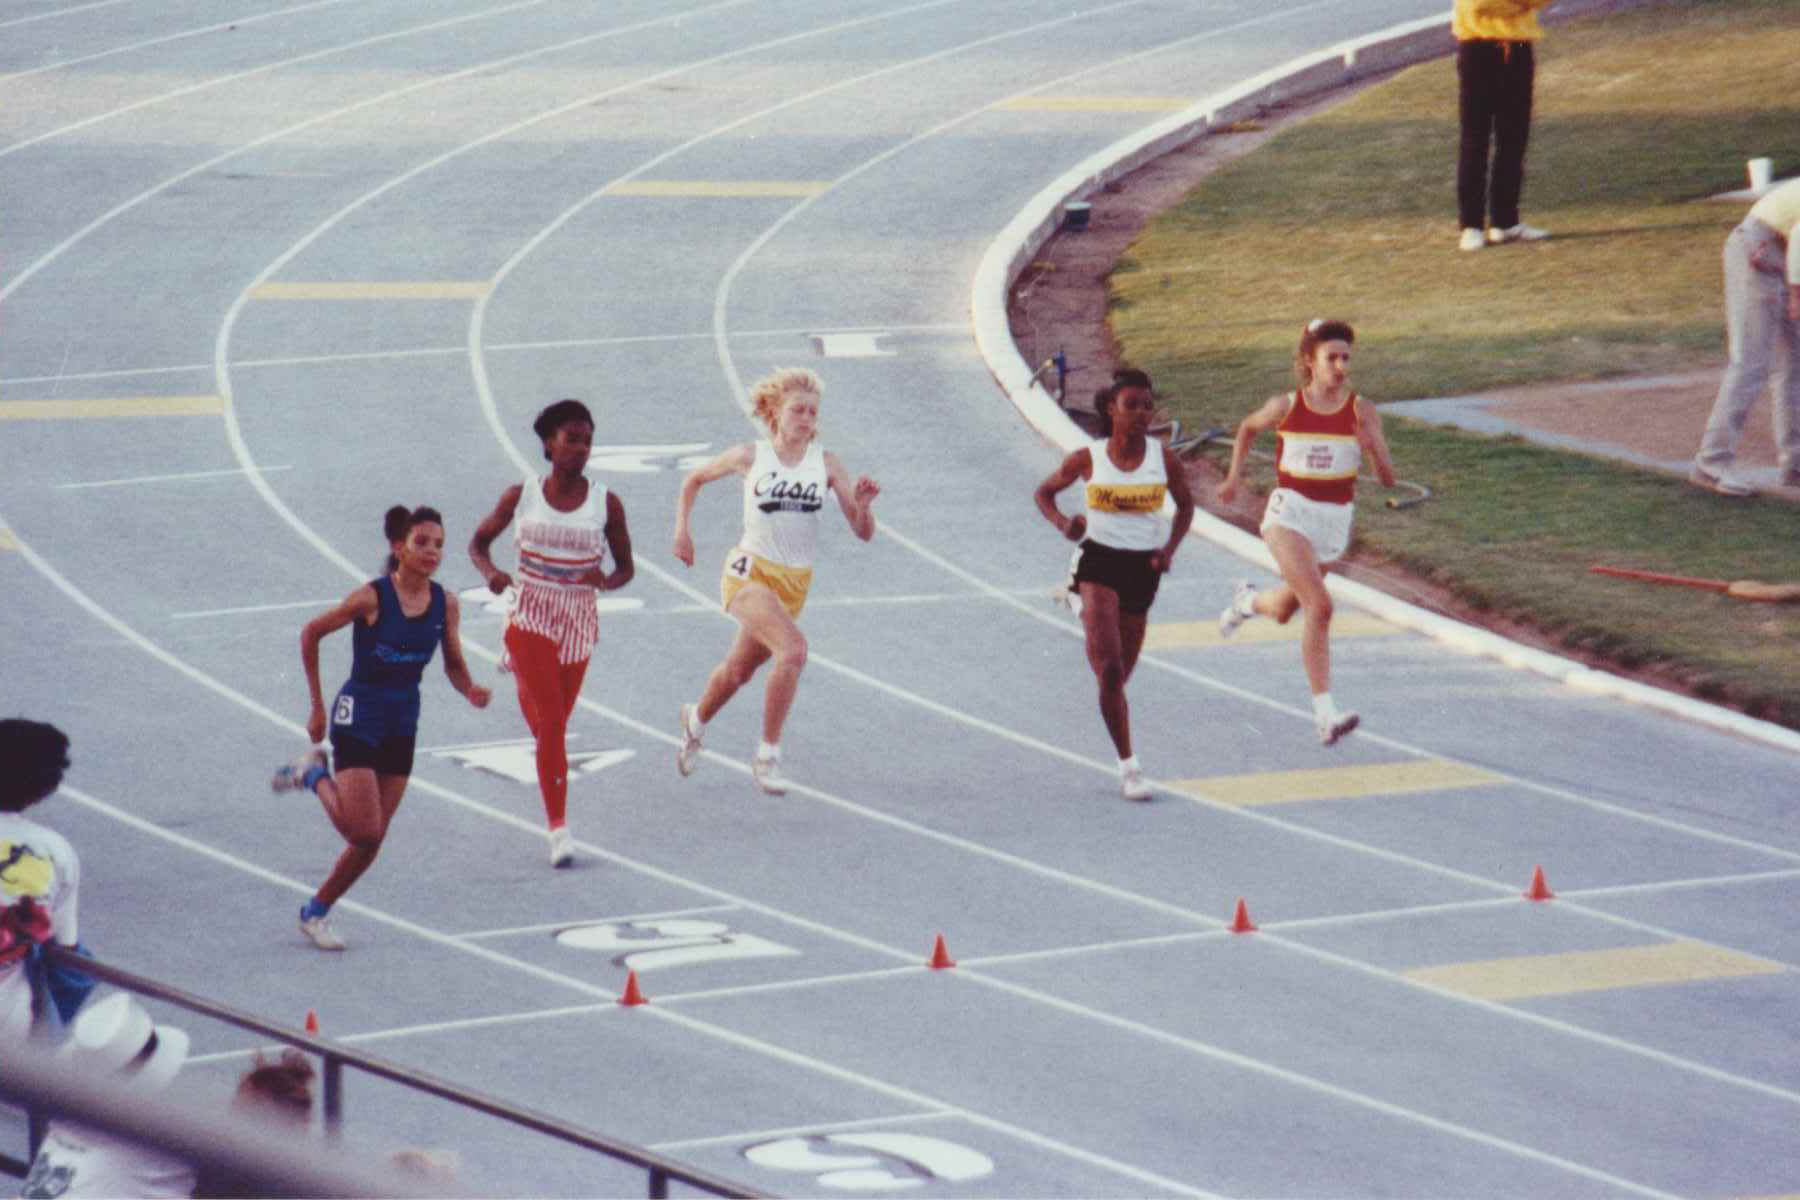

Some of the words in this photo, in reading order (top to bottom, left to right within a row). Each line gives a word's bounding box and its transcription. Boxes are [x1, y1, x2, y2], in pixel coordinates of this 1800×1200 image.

[754, 471, 818, 502] Casa
[731, 556, 748, 576] 4
[338, 698, 351, 721] 6
